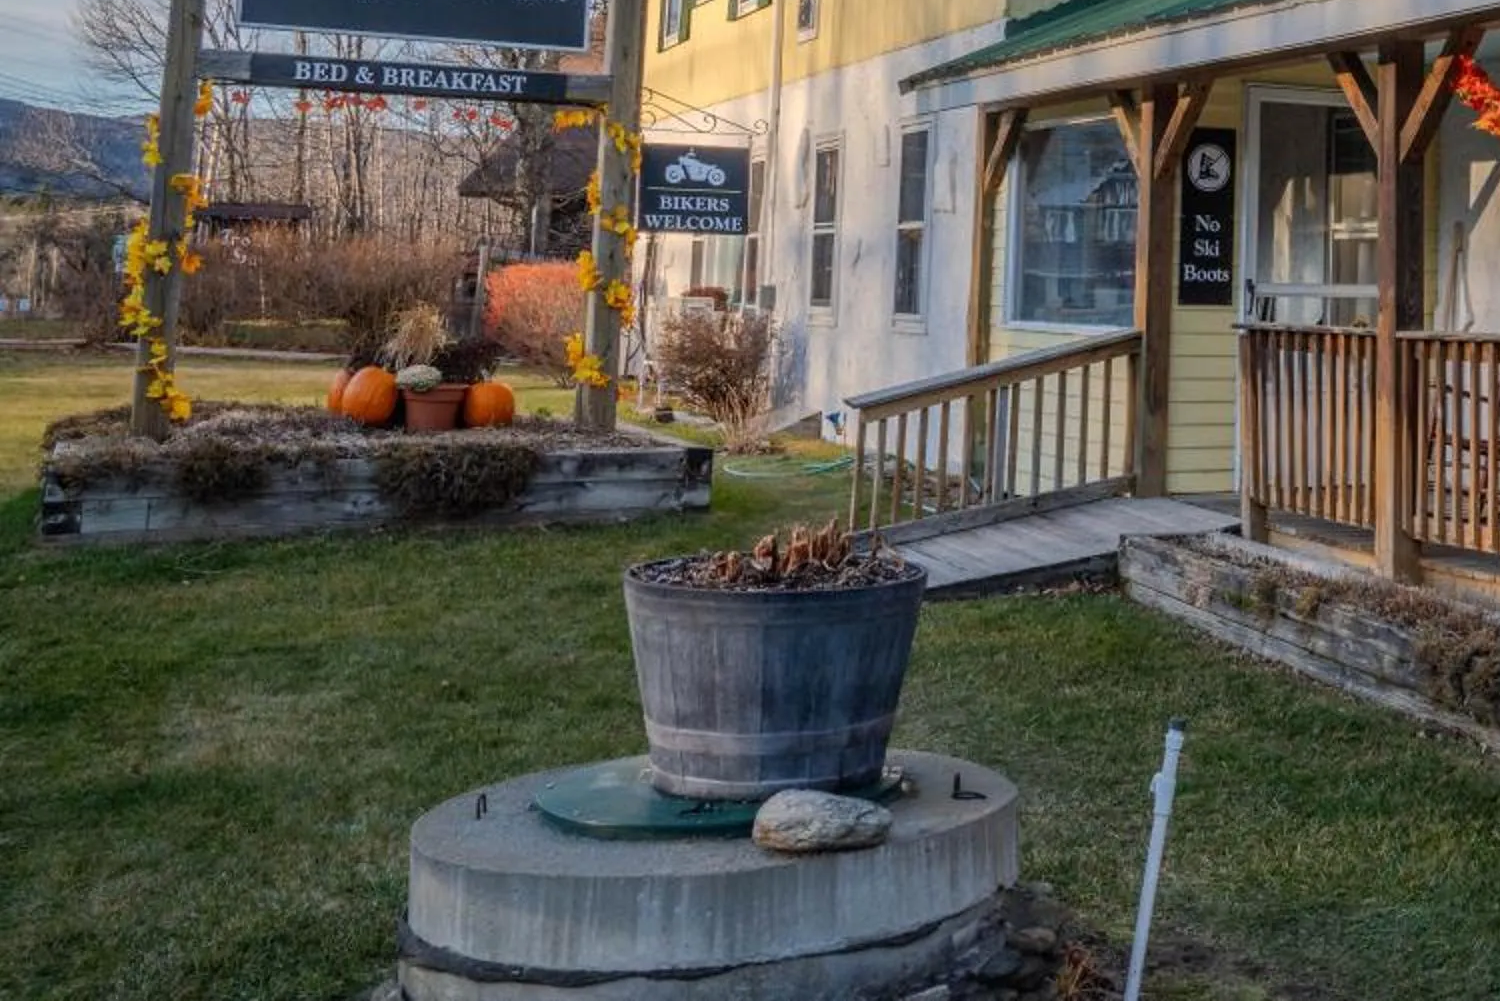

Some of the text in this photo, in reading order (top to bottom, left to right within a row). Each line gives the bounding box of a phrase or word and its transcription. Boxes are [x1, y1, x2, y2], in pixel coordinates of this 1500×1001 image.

[294, 61, 527, 93] BED & BREAKFAST
[659, 195, 730, 212] BIKERS
[644, 214, 743, 231] WELCOME
[1195, 214, 1221, 232] No
[1193, 239, 1219, 256] Ski
[1183, 264, 1230, 282] Boots
